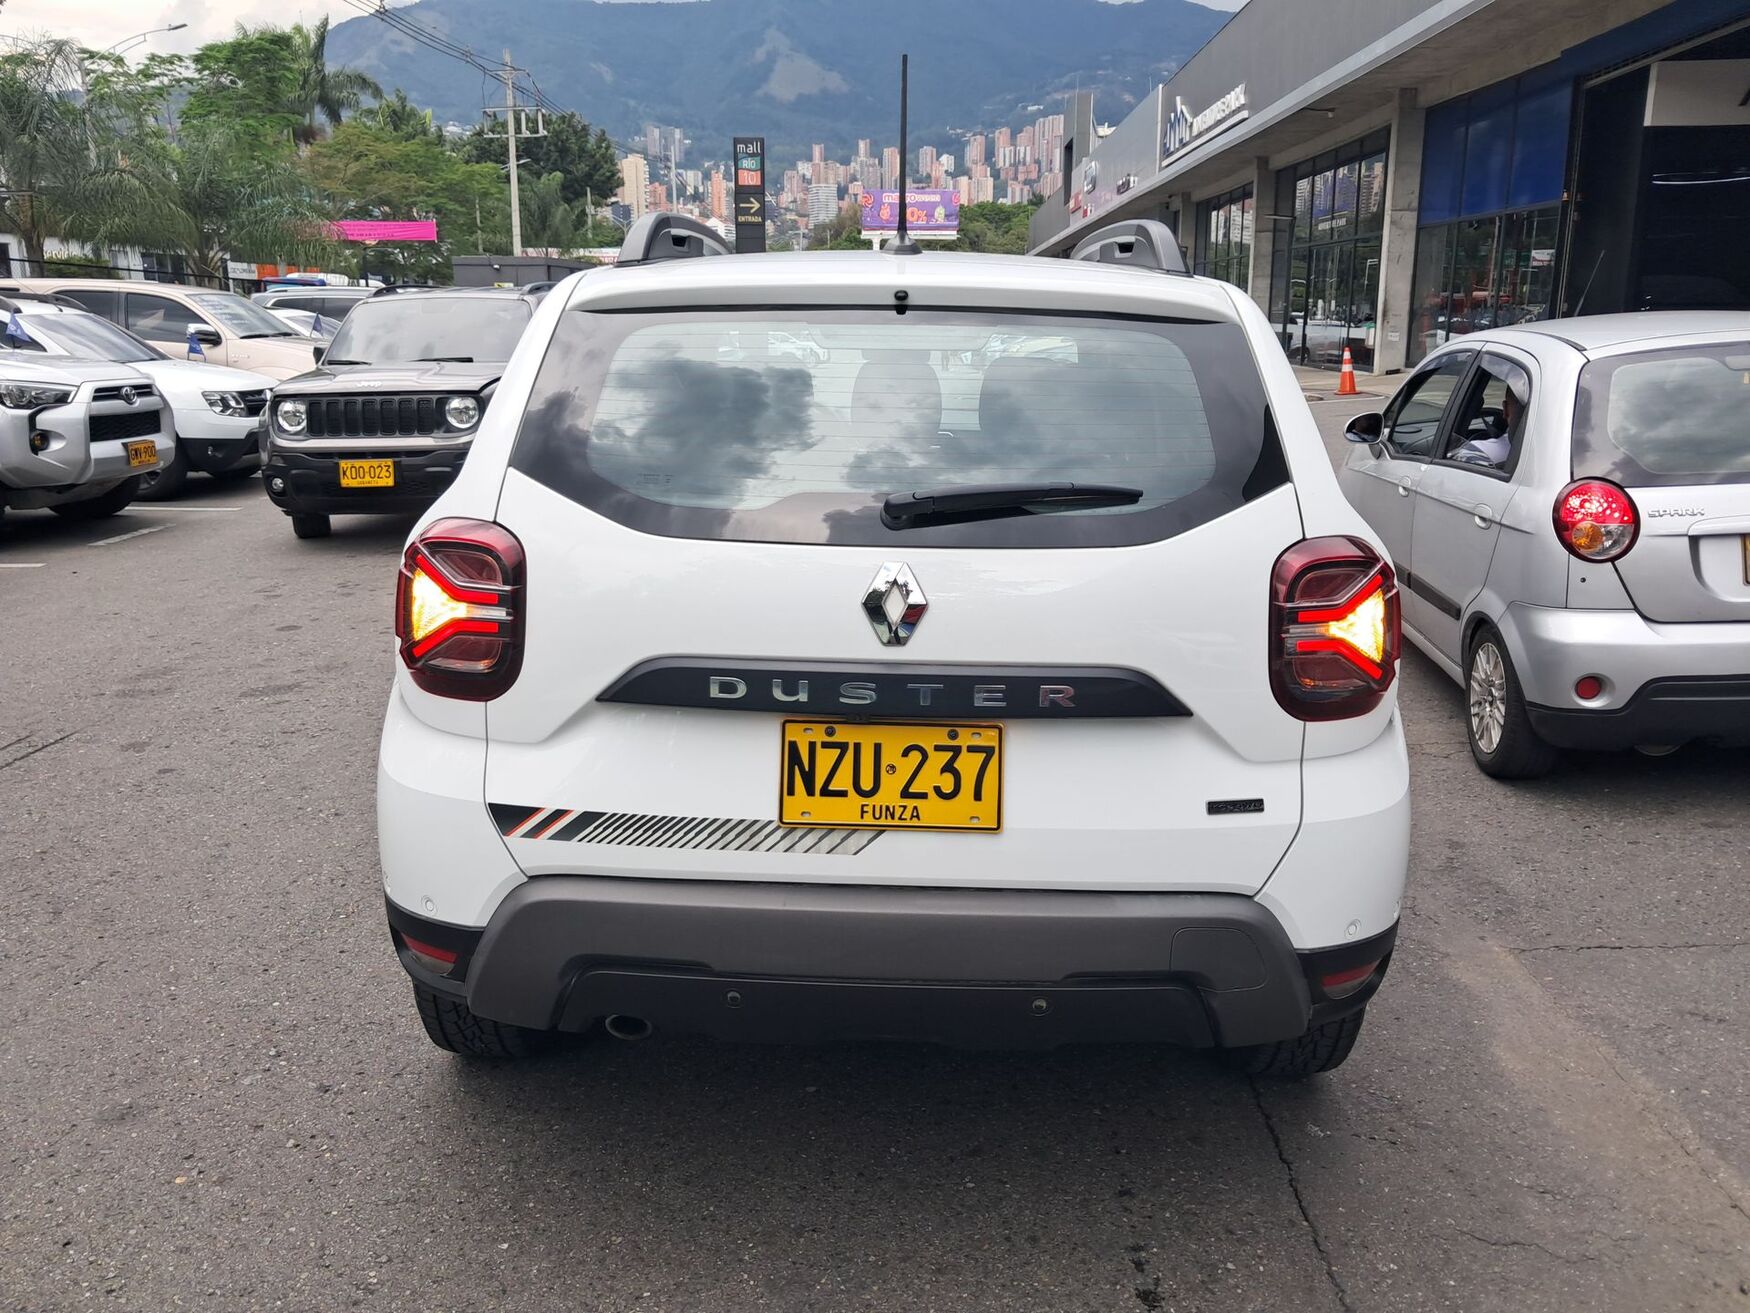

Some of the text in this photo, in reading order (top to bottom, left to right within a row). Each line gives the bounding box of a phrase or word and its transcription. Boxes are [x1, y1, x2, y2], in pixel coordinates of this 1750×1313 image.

[737, 141, 761, 154] mall
[743, 172, 756, 185] 10
[737, 215, 762, 223] ENTRADA
[1648, 507, 1705, 518] SPARK
[709, 675, 1076, 708] DUSTER
[860, 804, 921, 822] FUNZA
